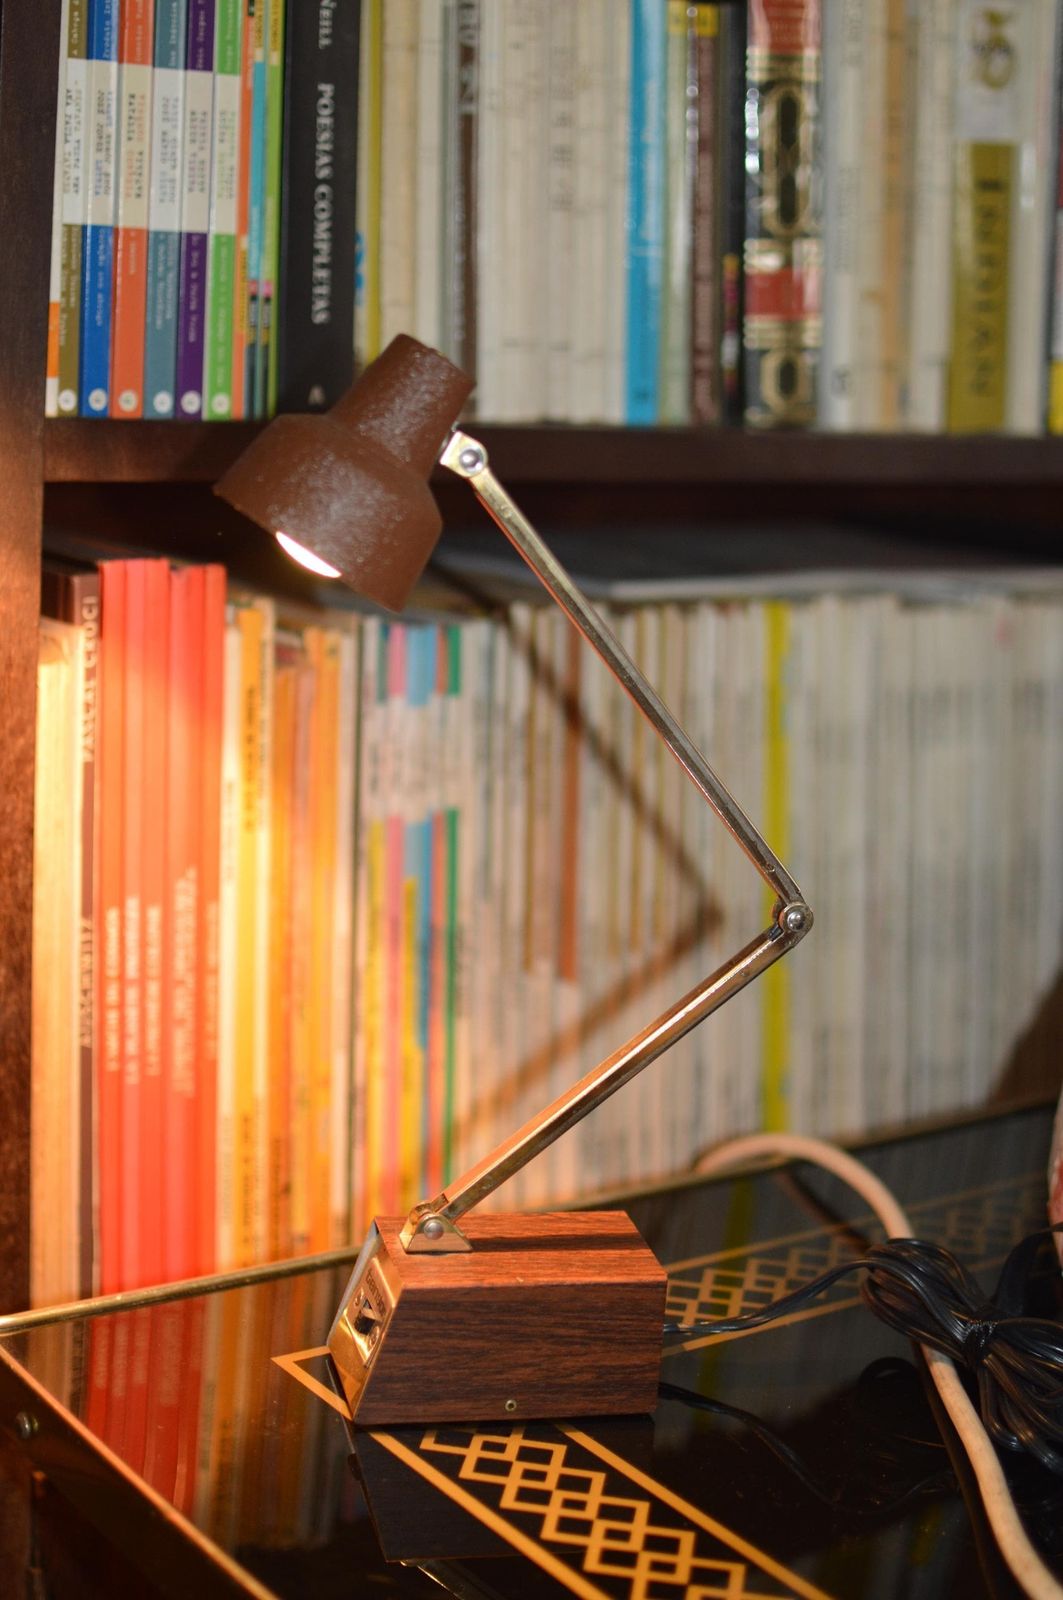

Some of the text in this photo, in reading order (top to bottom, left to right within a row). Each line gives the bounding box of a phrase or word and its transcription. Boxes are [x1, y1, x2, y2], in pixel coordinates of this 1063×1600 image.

[94, 90, 105, 196] JOSÉ JORGE LETRIA
[312, 84, 334, 325] POESIAS COMPLETAS
[82, 596, 98, 763] PASCAL CROCI
